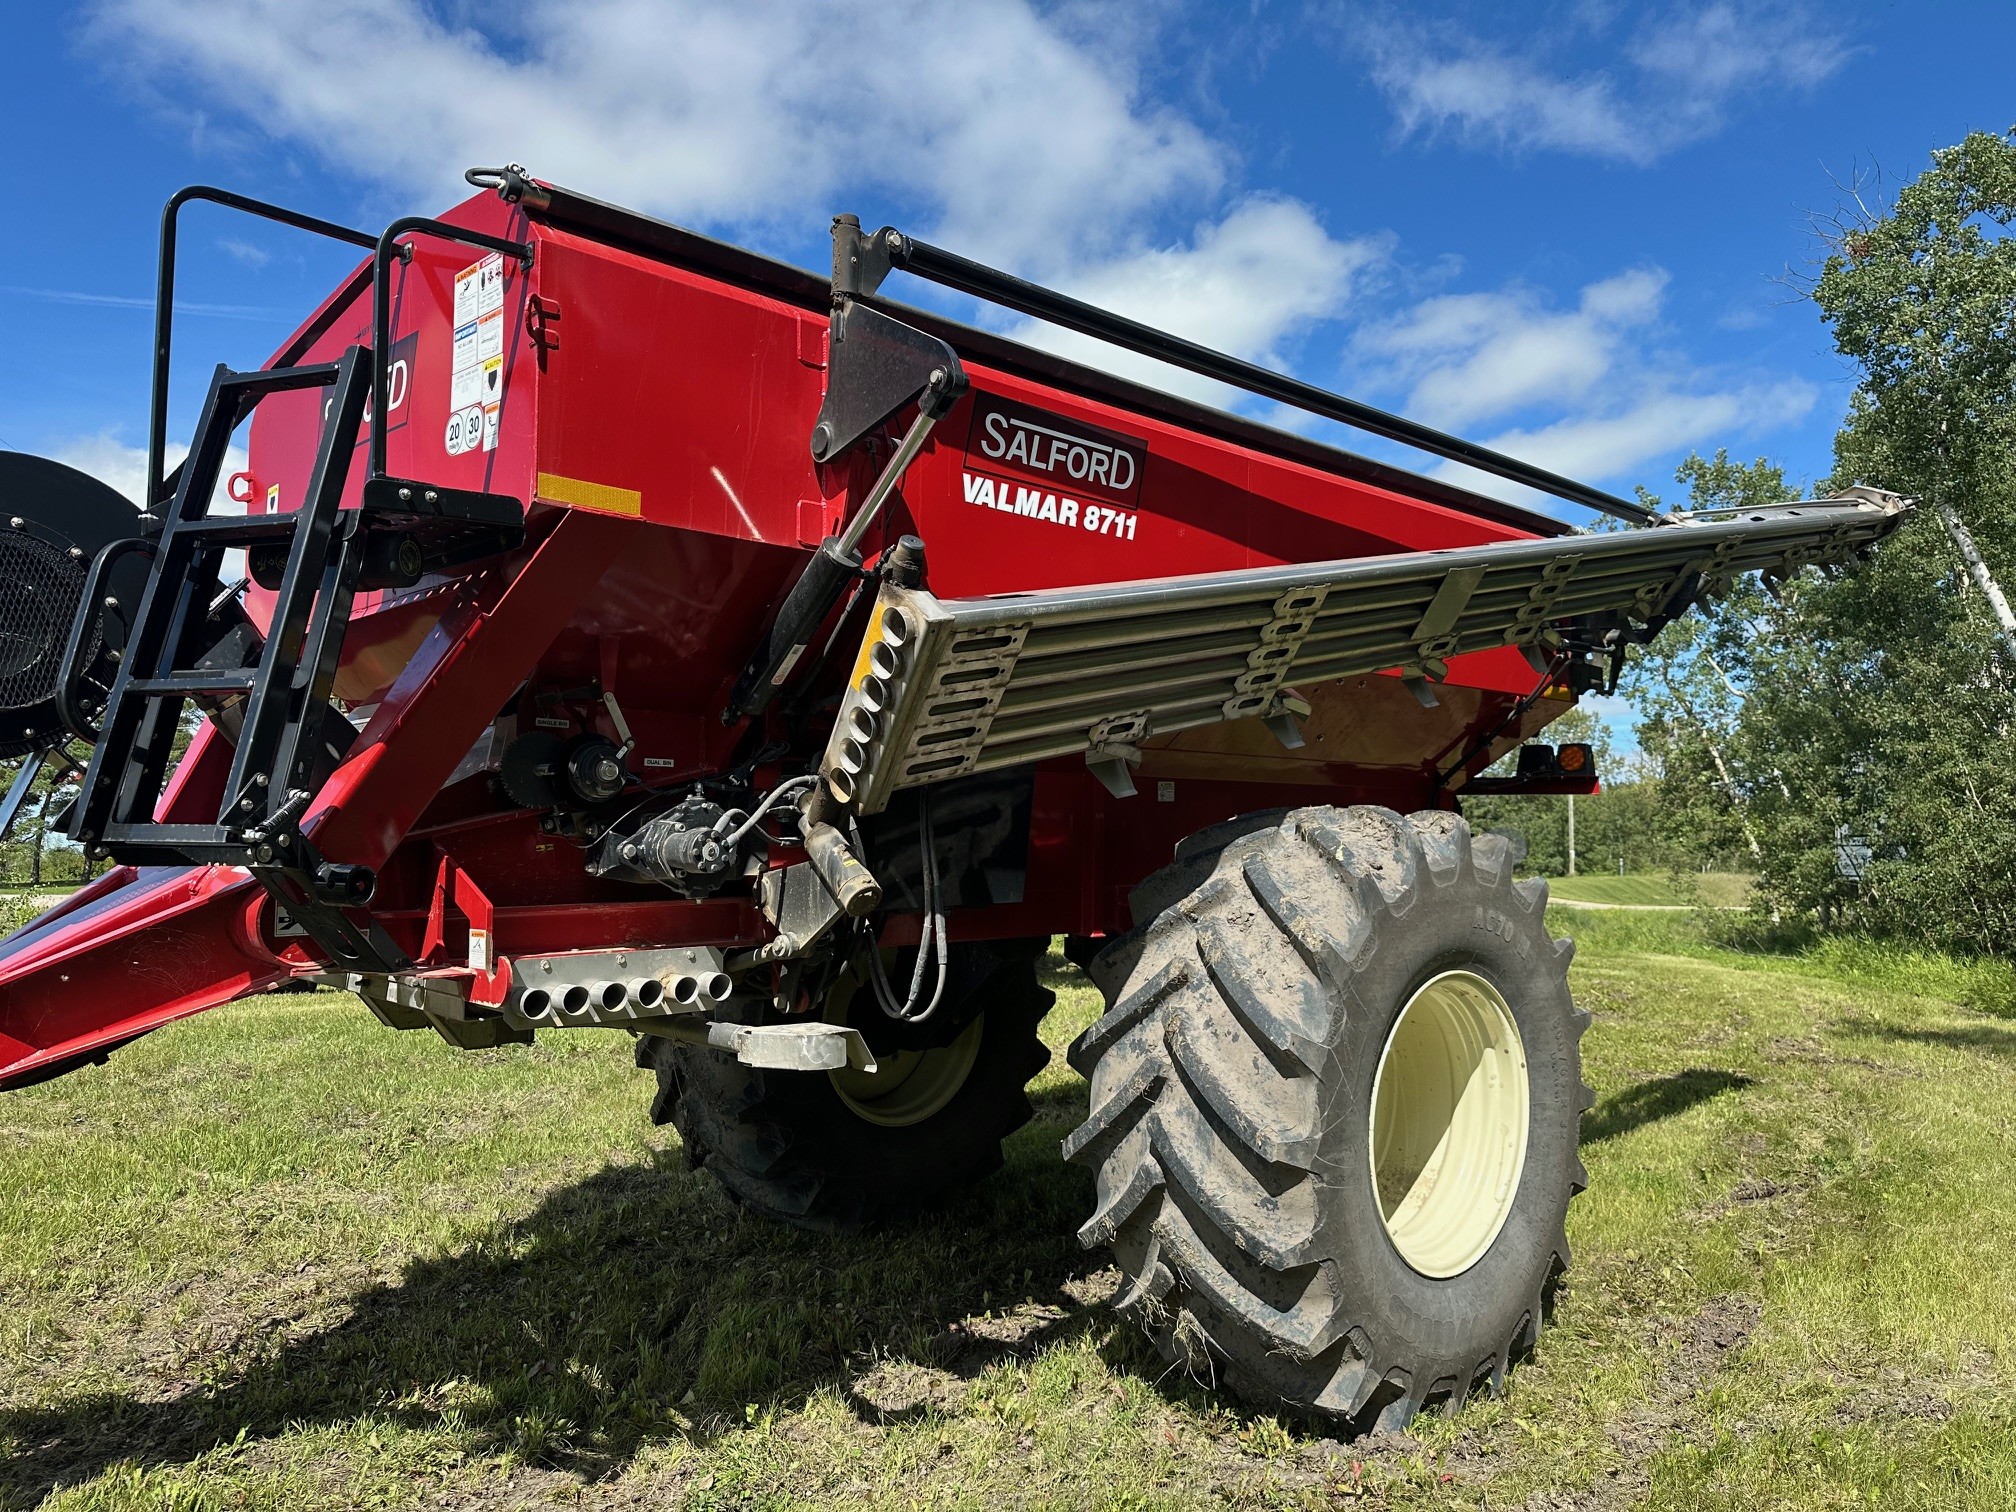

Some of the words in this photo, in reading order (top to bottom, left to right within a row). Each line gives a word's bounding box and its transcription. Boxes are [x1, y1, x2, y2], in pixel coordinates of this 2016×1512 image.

[449, 422, 460, 441] 20
[469, 415, 479, 435] 30
[981, 412, 1135, 490] SALFORD
[962, 473, 1080, 528] VALMAR
[1083, 505, 1138, 541] 8711
[1472, 904, 1514, 944] AC70
